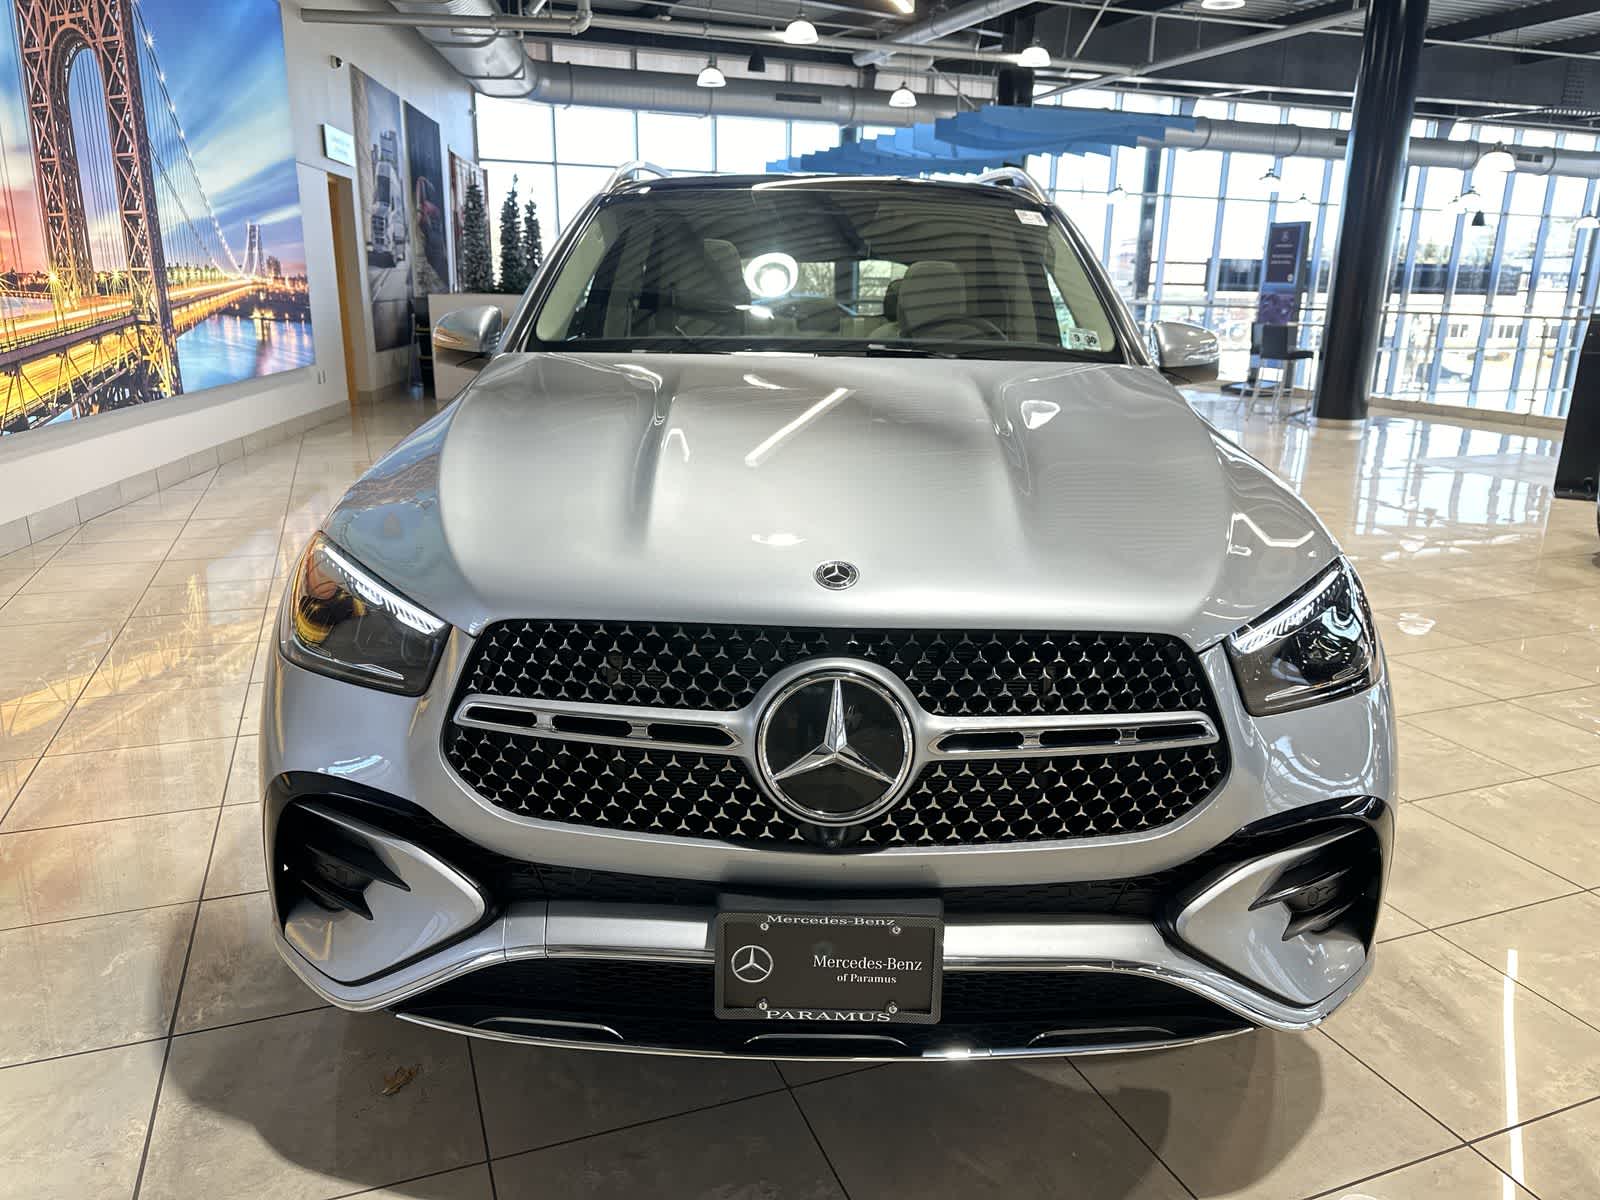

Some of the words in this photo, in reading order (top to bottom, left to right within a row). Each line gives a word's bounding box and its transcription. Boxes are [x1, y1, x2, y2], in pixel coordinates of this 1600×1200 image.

[766, 914, 897, 927] Mercedes-Benz
[813, 955, 923, 971] Mercedes-Benz
[836, 973, 848, 983] of
[849, 974, 898, 985] Paramus
[766, 1011, 892, 1023] PARAMUS
